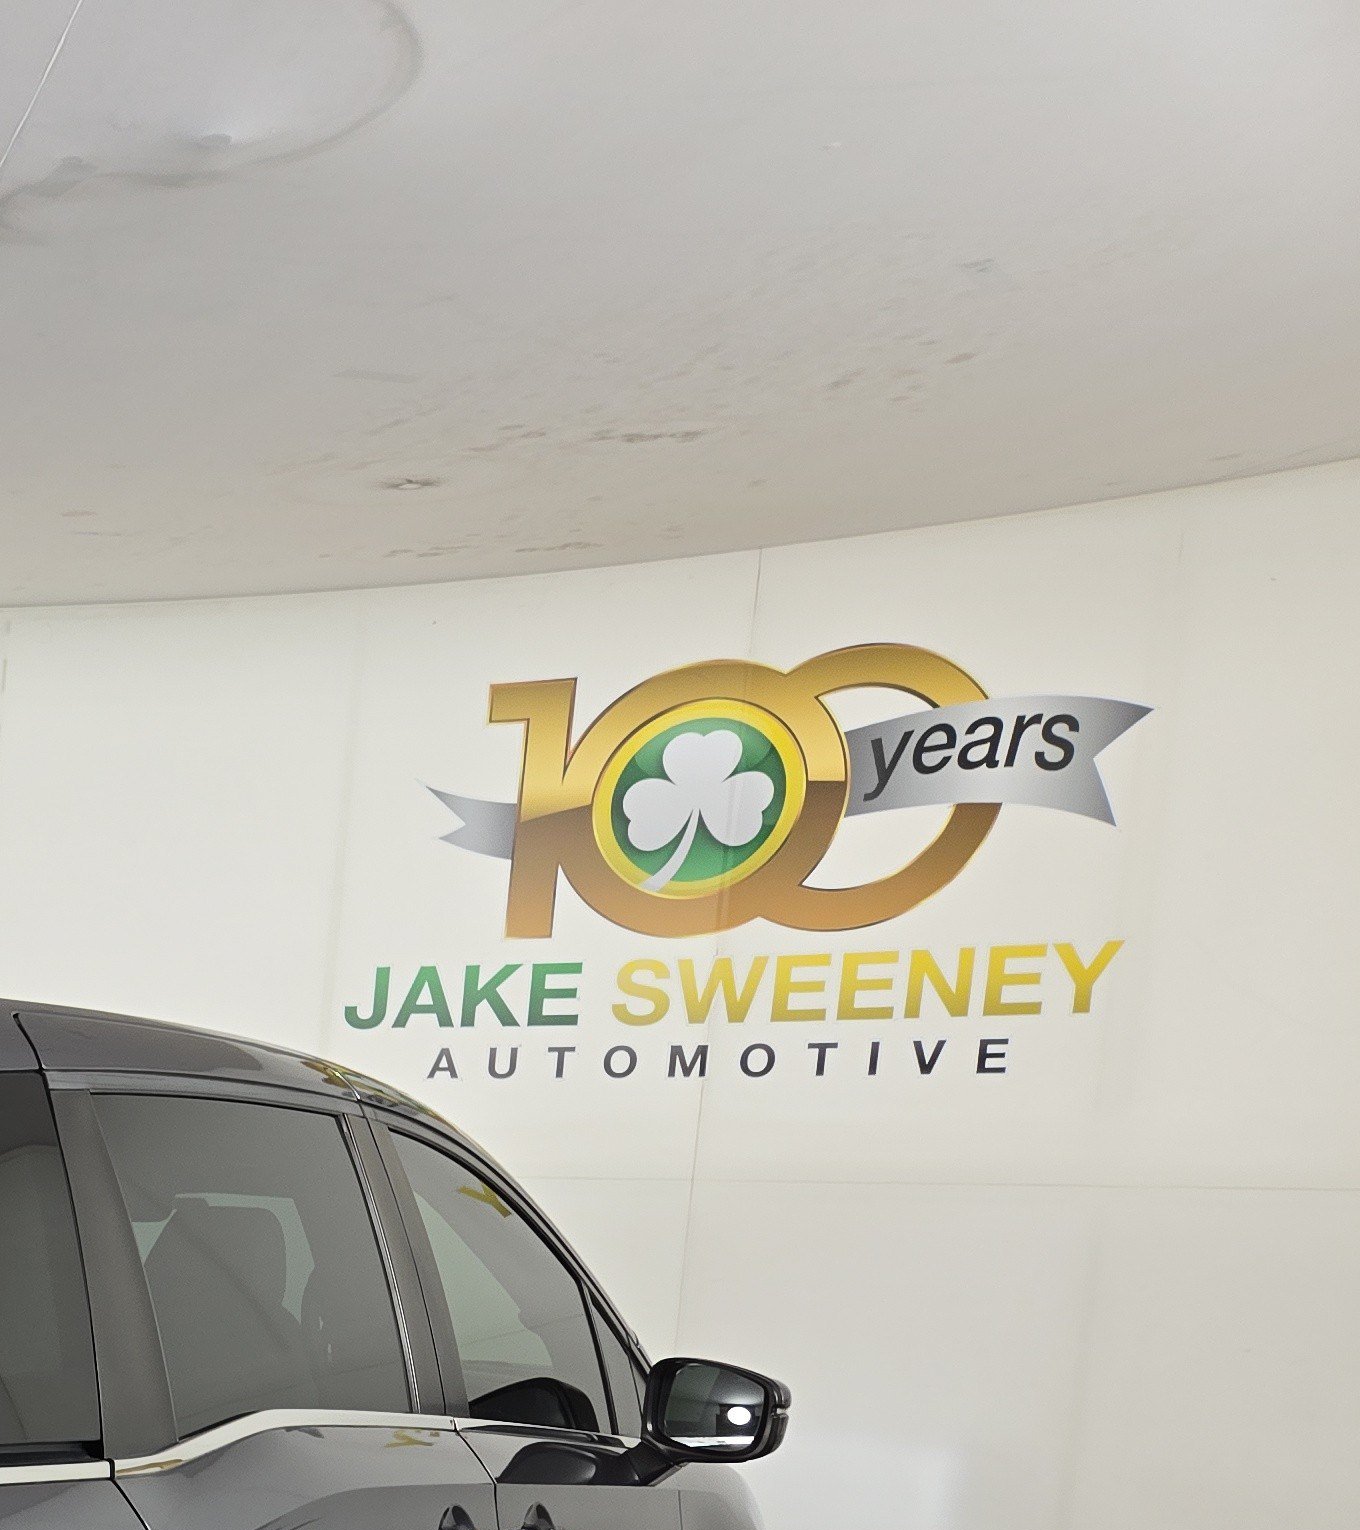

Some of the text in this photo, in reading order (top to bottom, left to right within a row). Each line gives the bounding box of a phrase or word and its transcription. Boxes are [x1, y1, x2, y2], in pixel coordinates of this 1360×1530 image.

[487, 643, 1003, 939] 100
[862, 711, 1080, 802] years
[344, 940, 1125, 1030] JAKE SWEENEY
[426, 1037, 1010, 1081] AUTOMOTIVE
